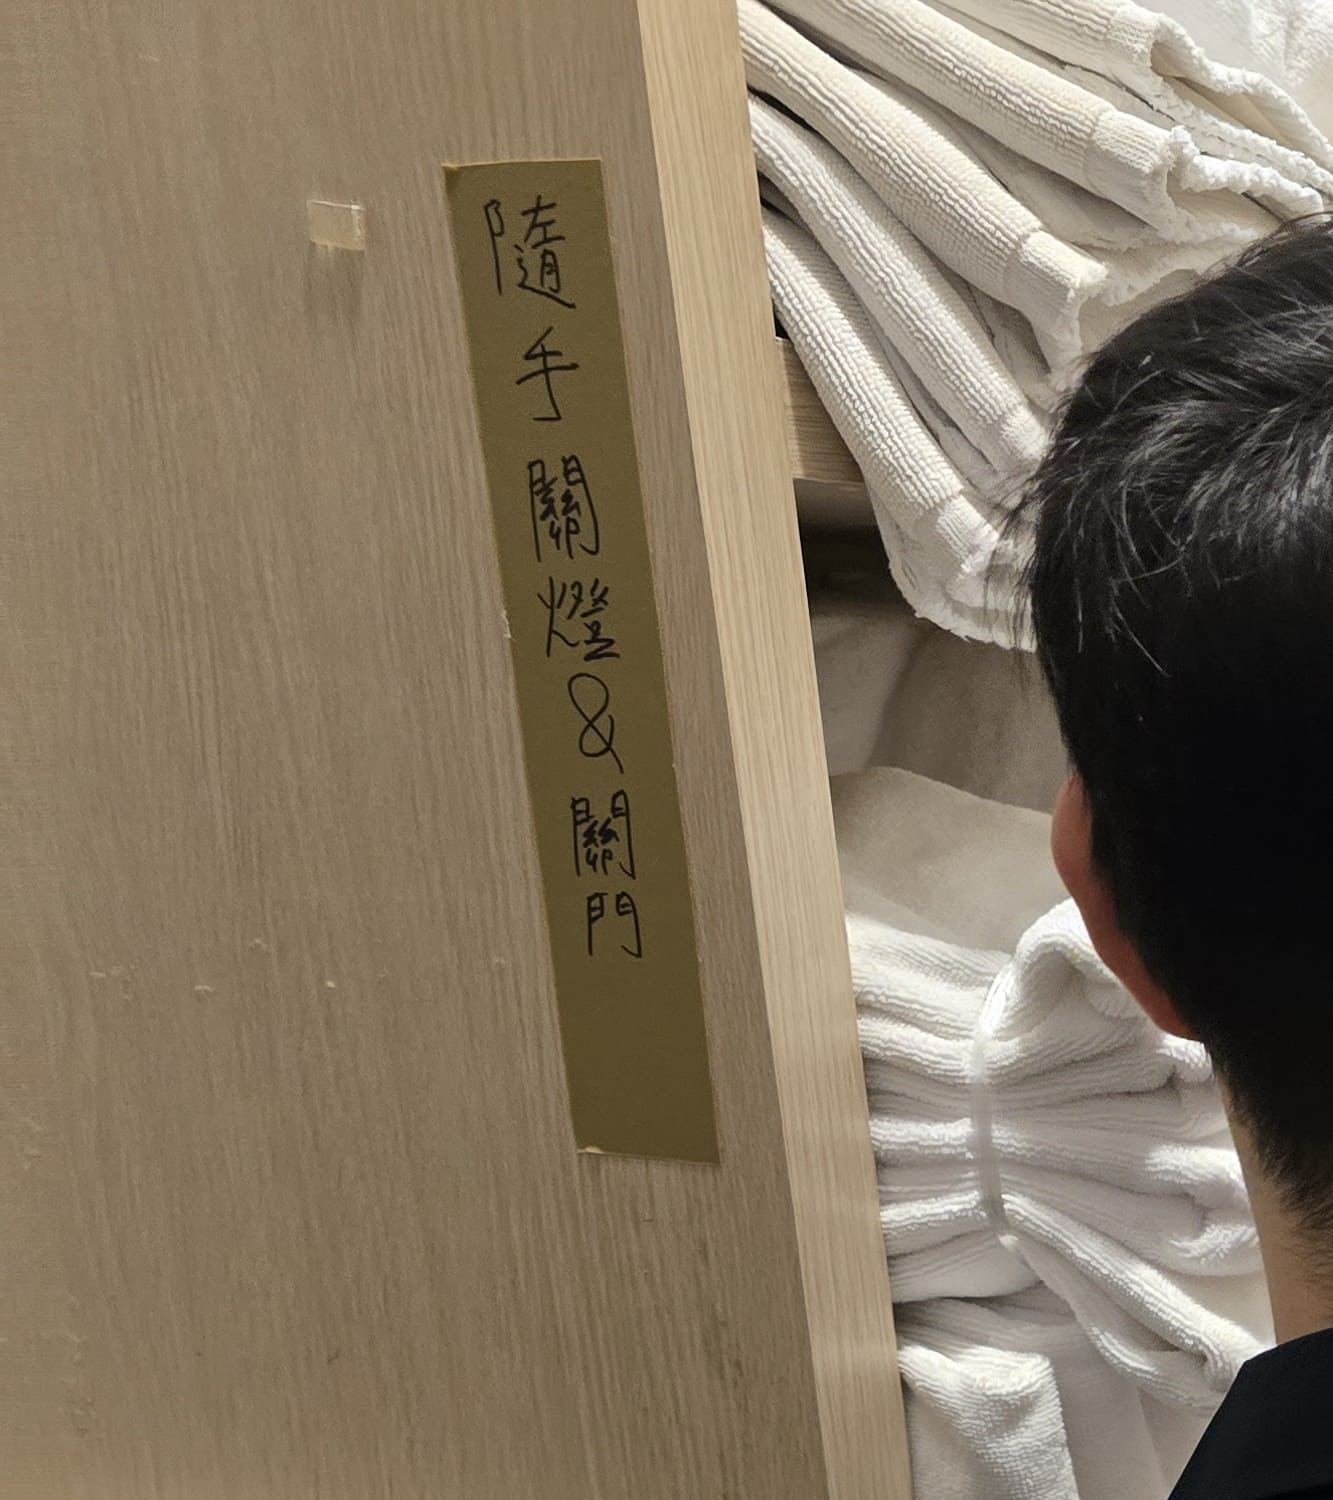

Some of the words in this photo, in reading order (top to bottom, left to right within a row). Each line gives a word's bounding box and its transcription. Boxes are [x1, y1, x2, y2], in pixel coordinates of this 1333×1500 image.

[484, 194, 644, 959] 隨手關燈&關門
